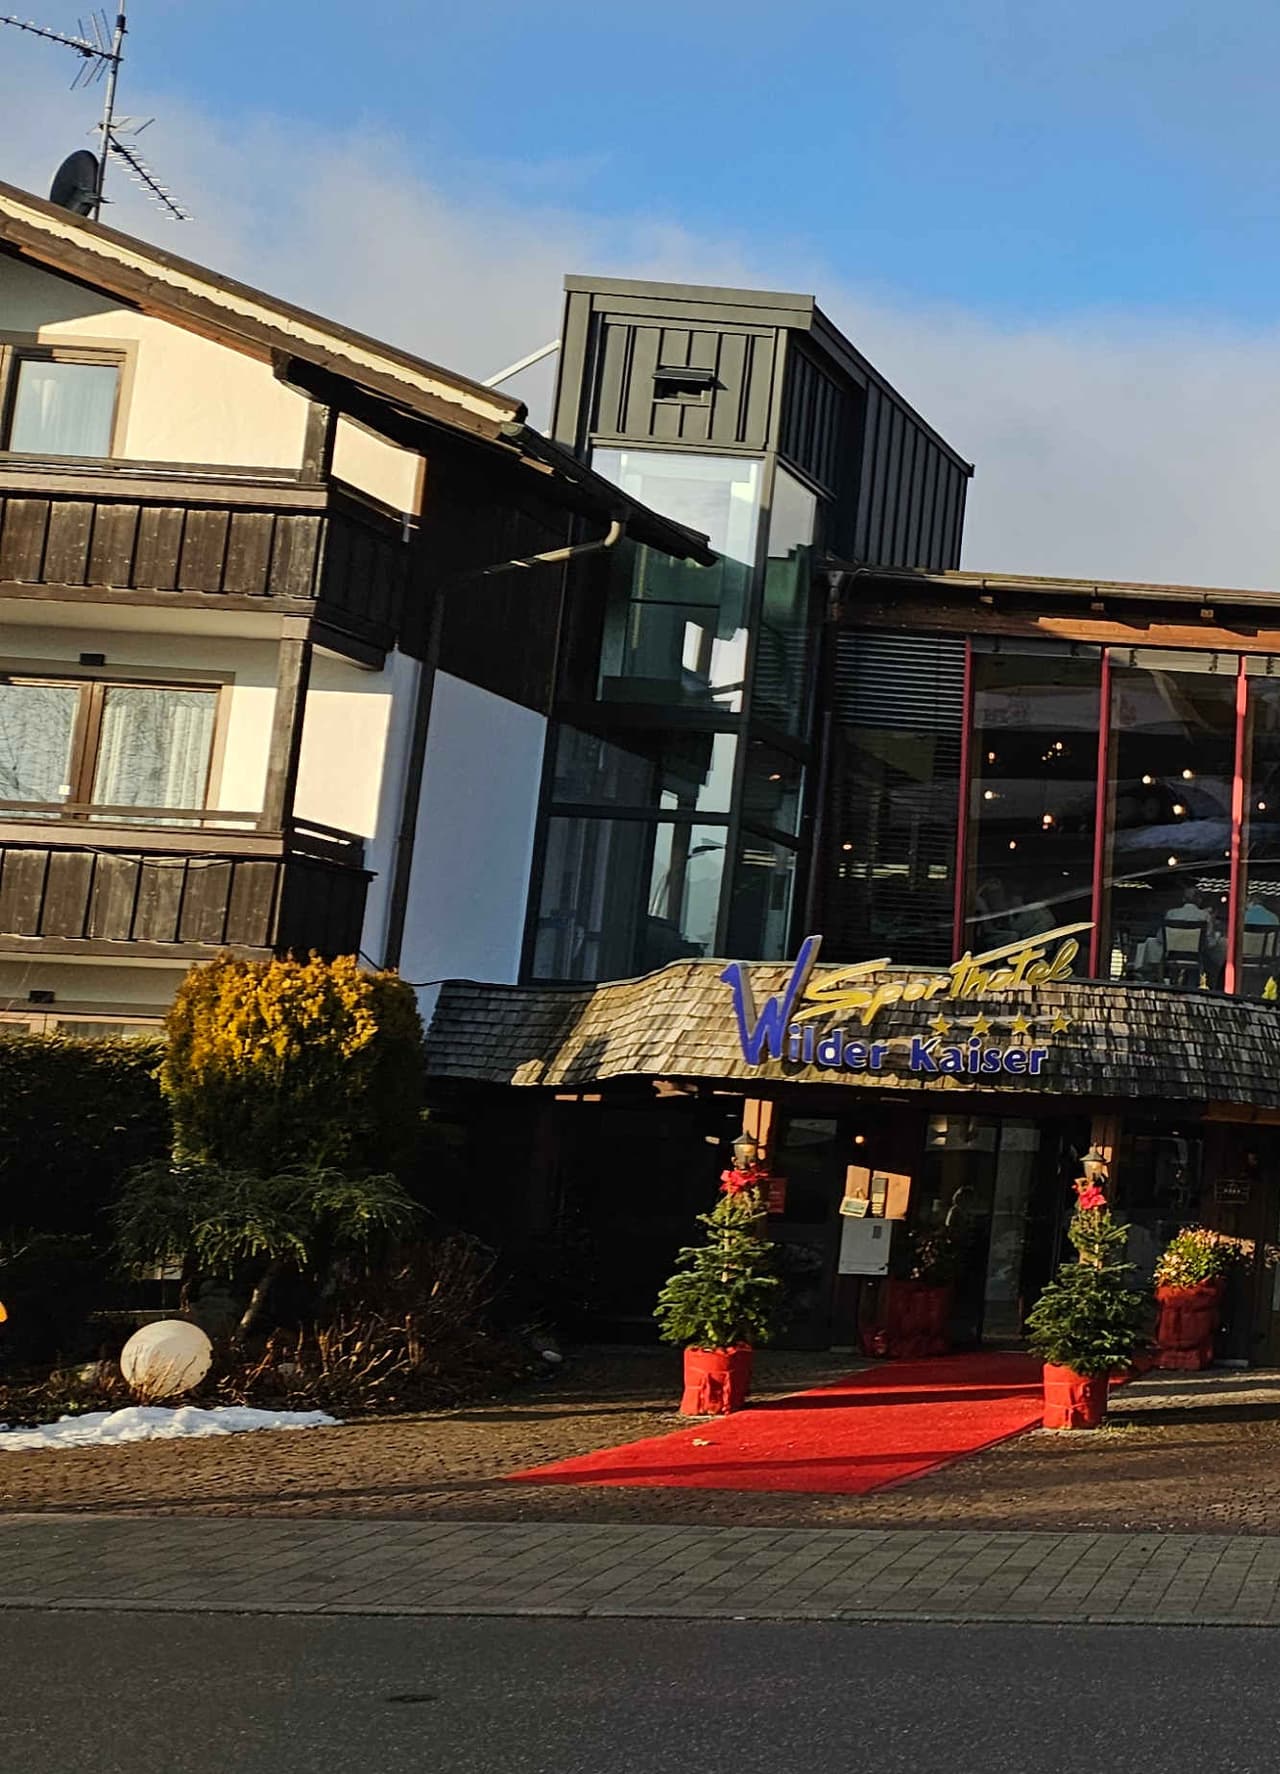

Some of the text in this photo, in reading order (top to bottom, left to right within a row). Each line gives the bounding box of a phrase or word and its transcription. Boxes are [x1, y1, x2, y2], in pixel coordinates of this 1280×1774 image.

[720, 934, 1049, 1075] Wilder Kaiser
[792, 922, 1097, 1026] Sporthotel
